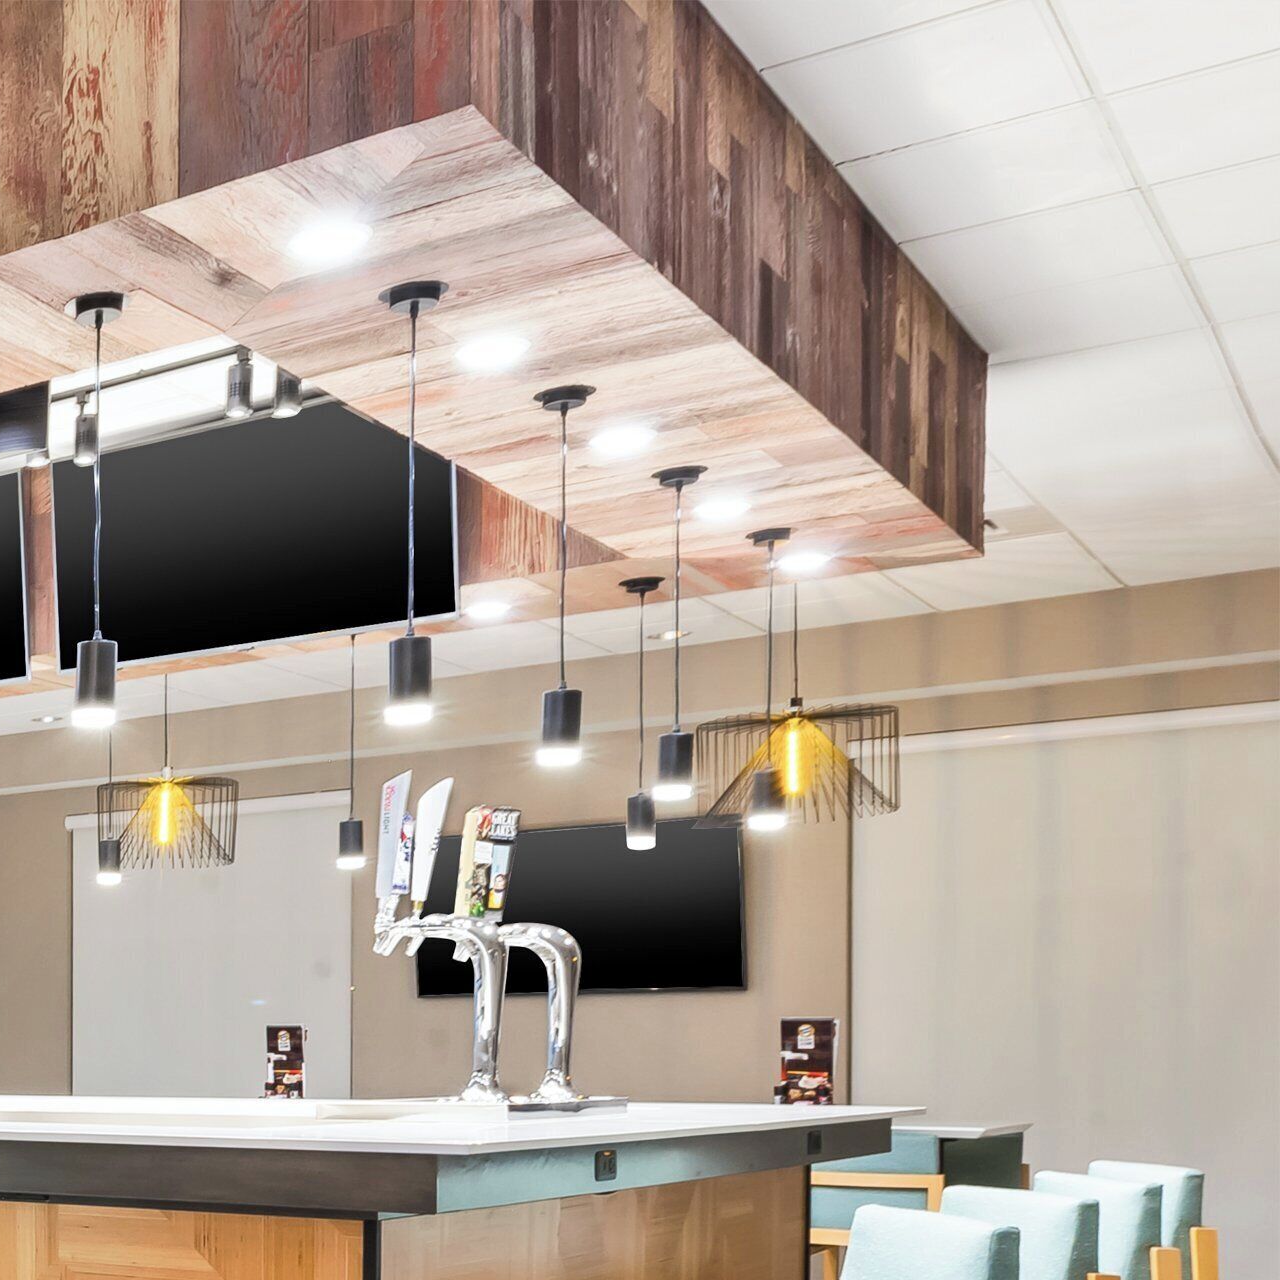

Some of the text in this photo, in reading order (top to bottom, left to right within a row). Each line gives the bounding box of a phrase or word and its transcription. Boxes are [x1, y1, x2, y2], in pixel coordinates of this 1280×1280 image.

[383, 812, 391, 834] LIGHT
[491, 811, 520, 824] GREAT
[490, 824, 518, 835] LAKES
